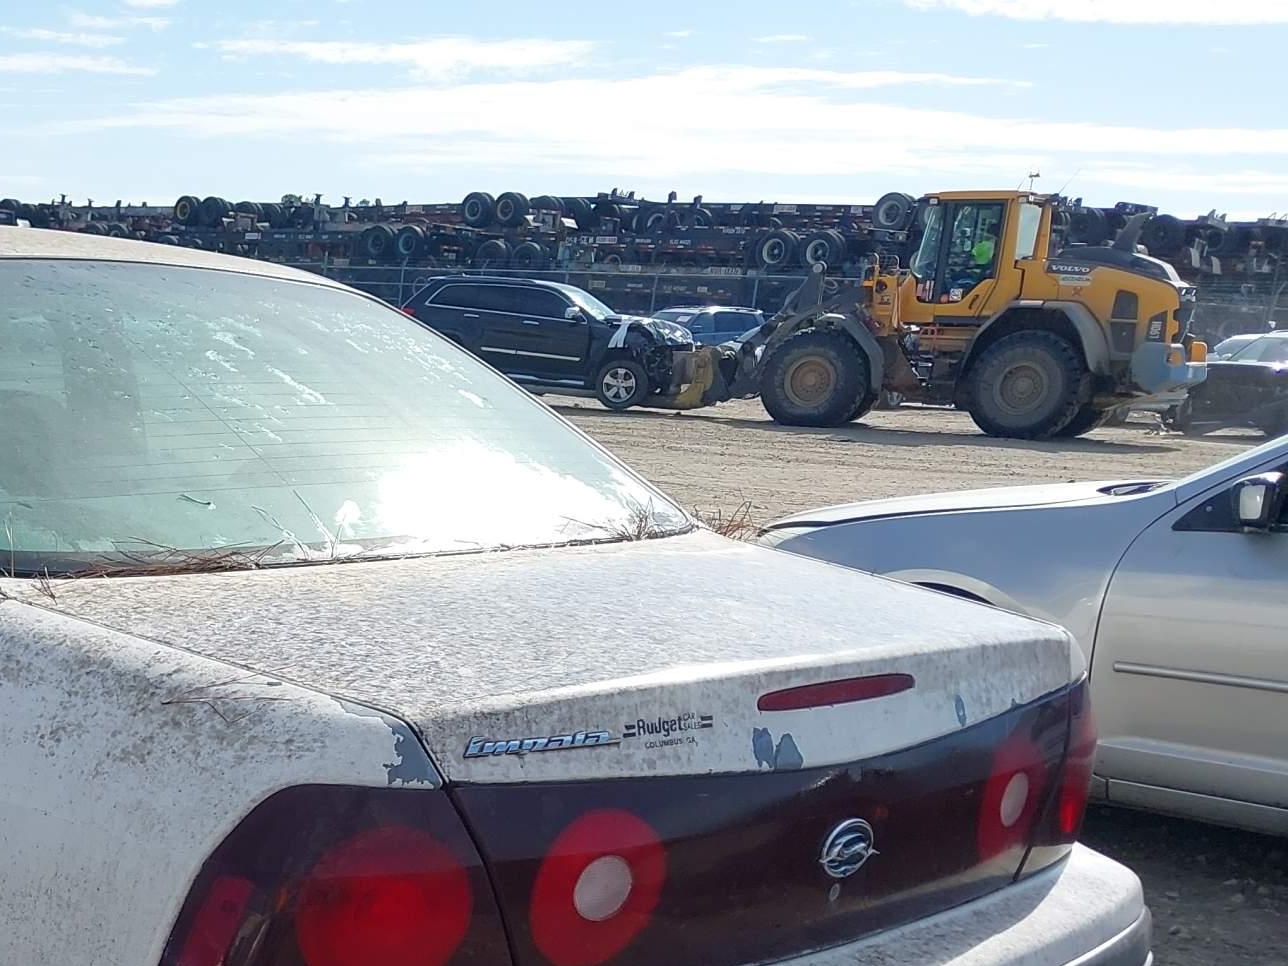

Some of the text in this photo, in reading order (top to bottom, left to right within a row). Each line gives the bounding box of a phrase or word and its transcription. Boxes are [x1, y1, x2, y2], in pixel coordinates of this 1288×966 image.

[1052, 265, 1090, 273] VOLVO
[463, 731, 610, 758] Impala
[645, 738, 683, 749] COLUMBUS
